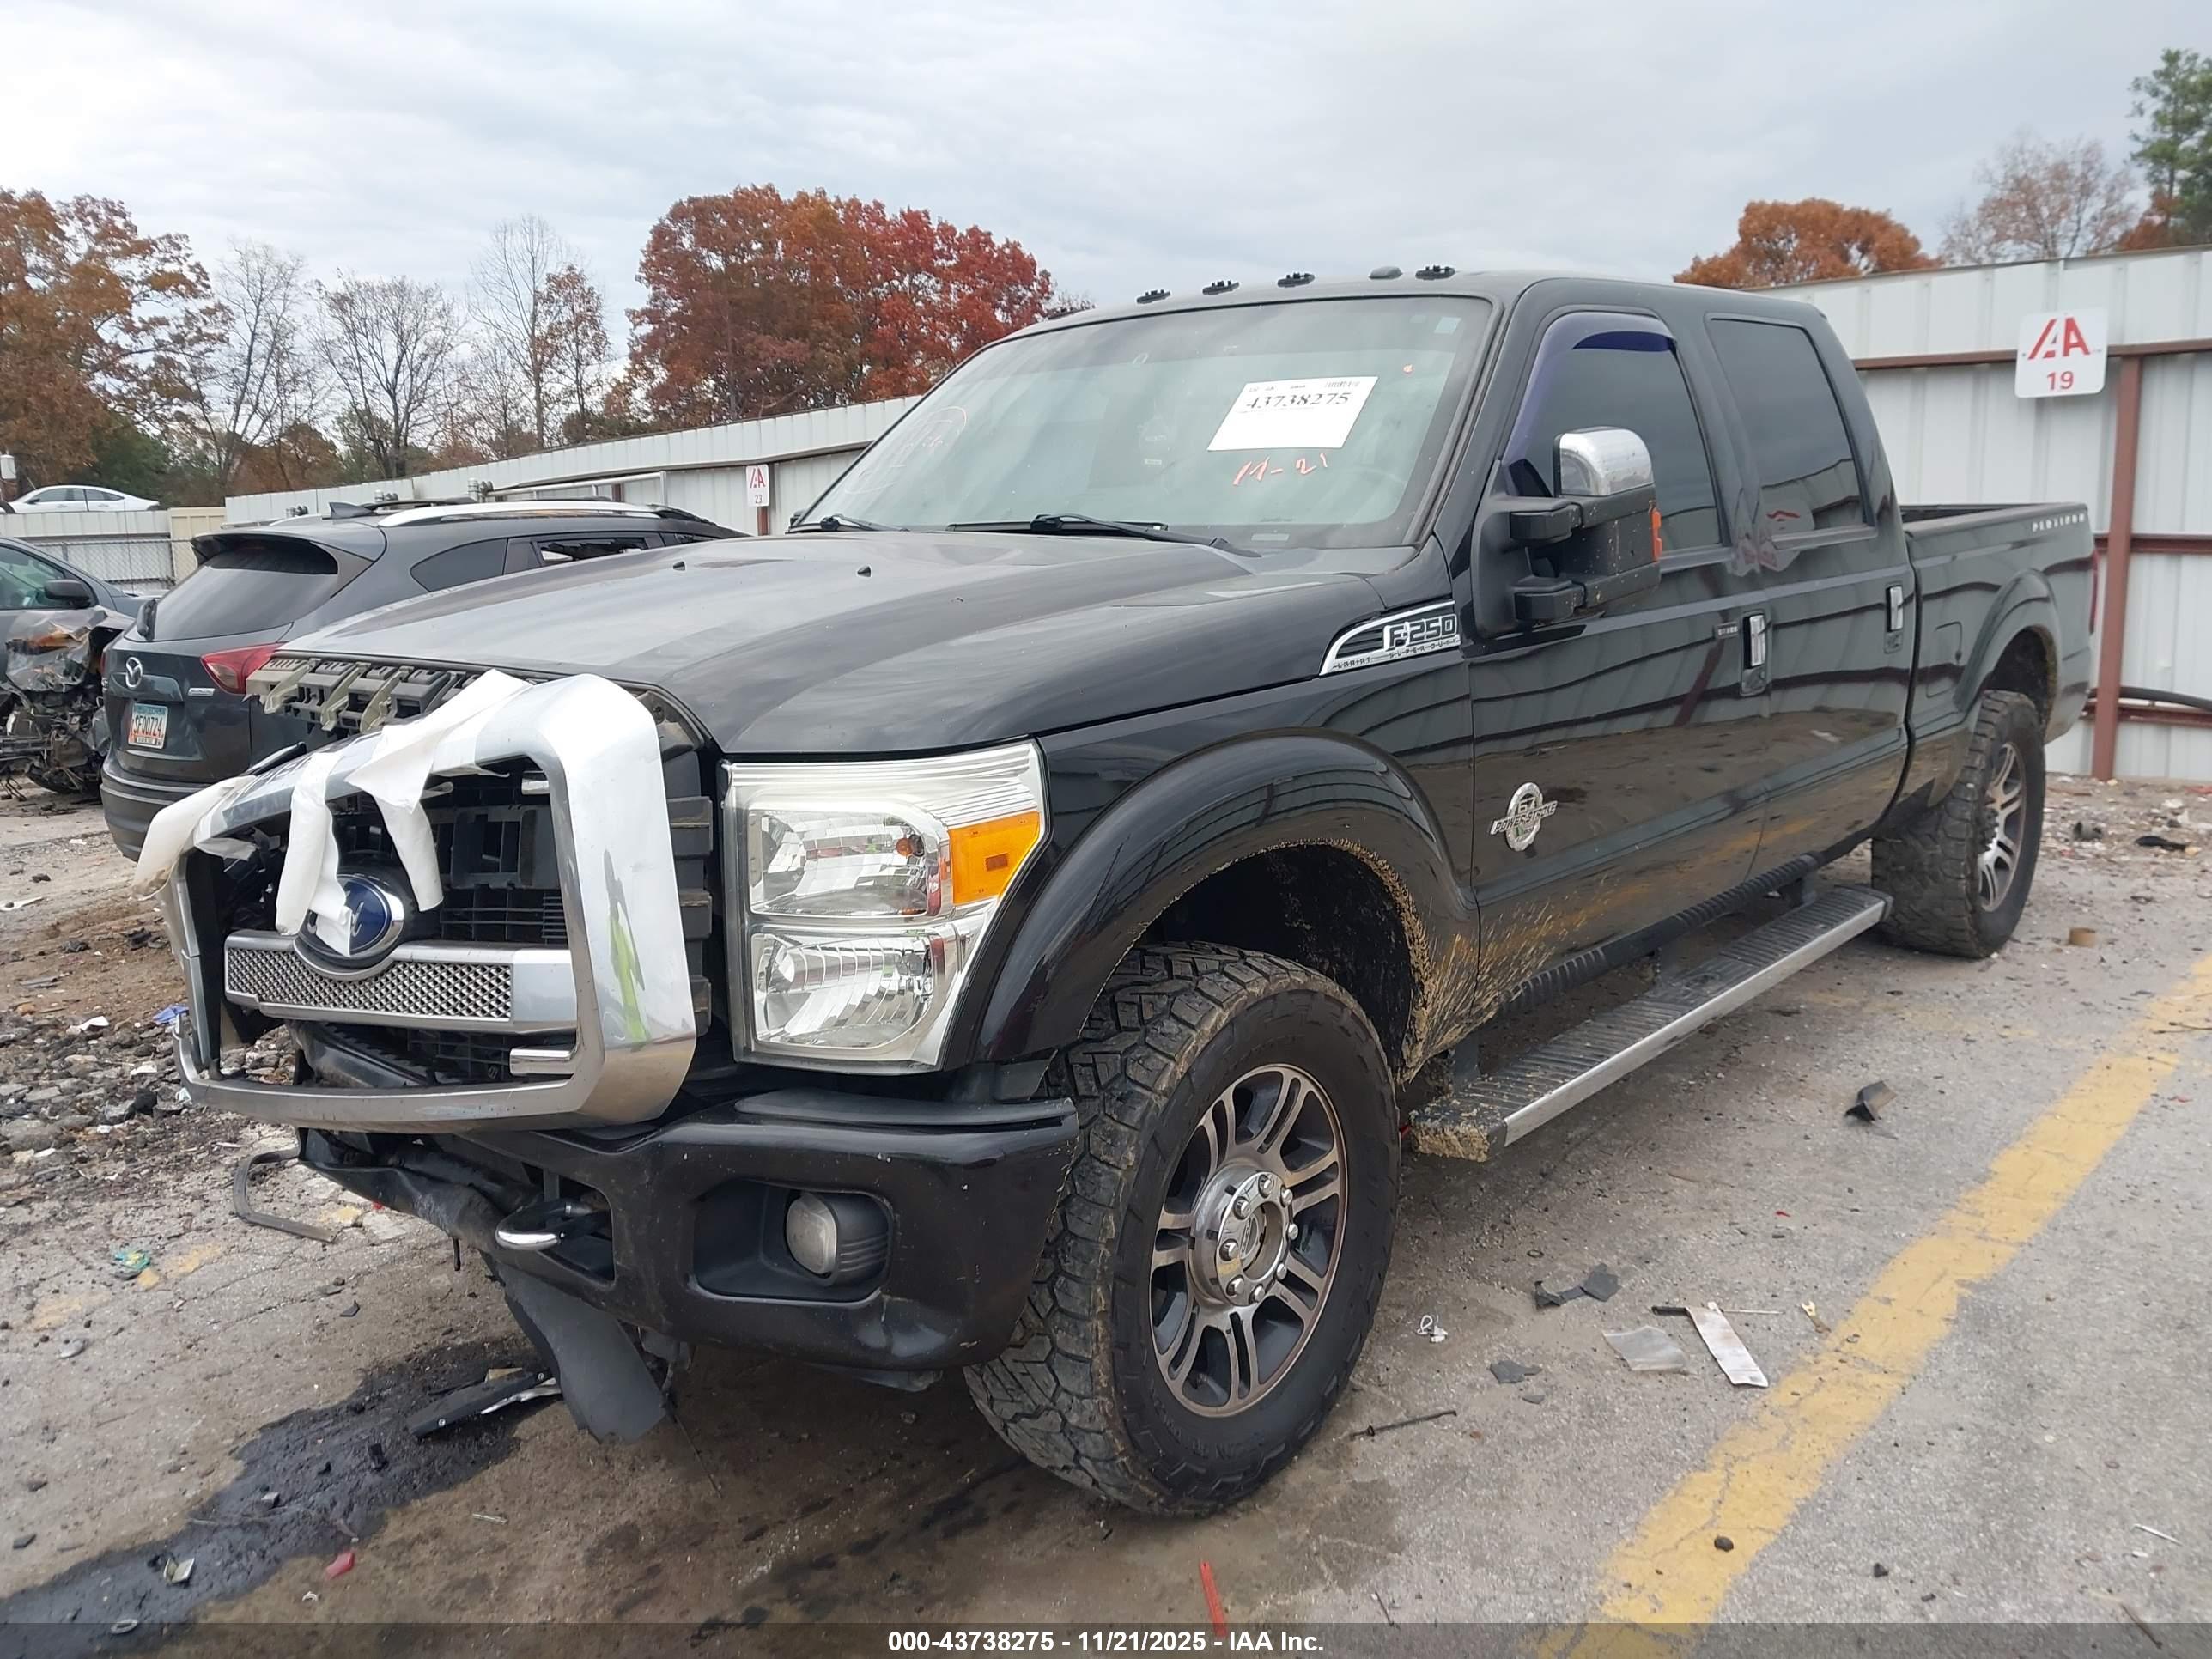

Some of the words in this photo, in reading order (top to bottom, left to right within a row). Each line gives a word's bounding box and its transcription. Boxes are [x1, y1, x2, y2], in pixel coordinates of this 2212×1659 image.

[2047, 370, 2074, 391] 19
[1245, 392, 1352, 410] 43738275
[1389, 646, 1425, 659] SUPER
